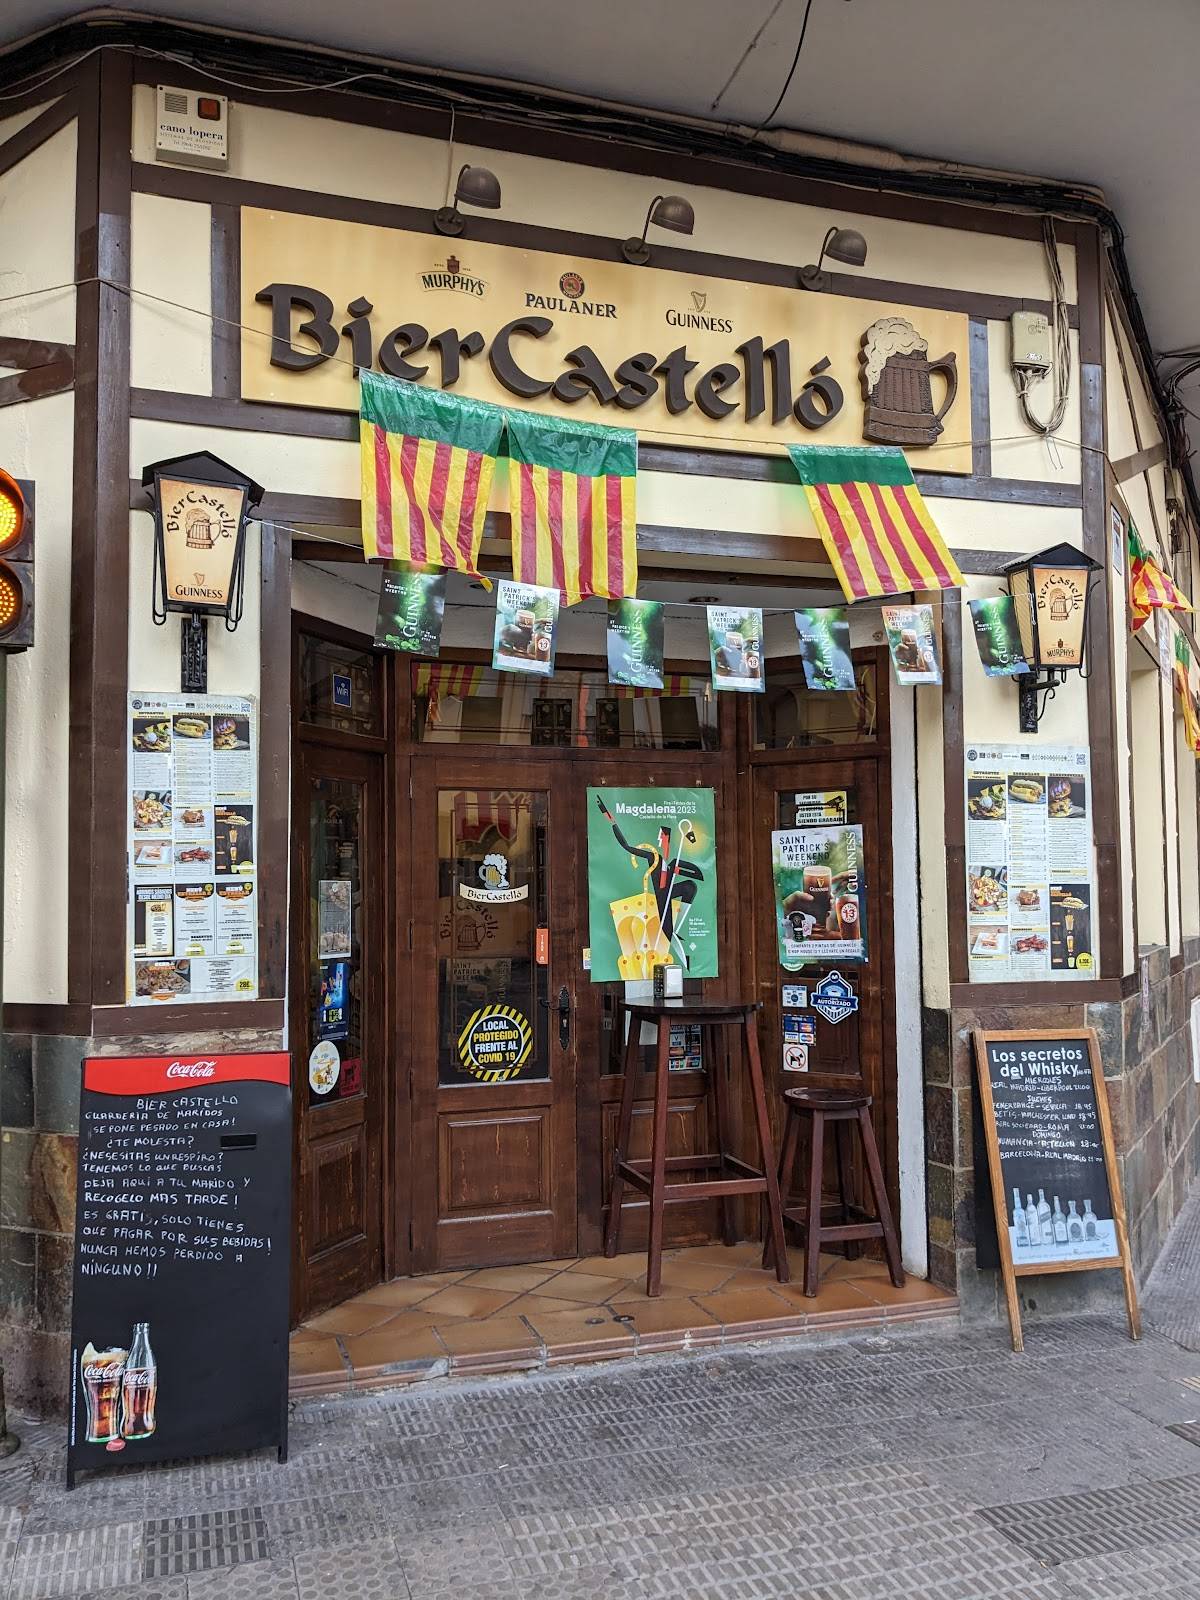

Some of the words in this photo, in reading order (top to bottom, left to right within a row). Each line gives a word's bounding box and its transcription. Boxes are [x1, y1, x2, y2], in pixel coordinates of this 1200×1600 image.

[160, 124, 186, 134] cano
[189, 126, 223, 140] lopera
[525, 292, 617, 319] PAULANER
[666, 309, 734, 333] GUINNESS
[255, 282, 844, 430] BierCastelló
[175, 585, 223, 598] GUINNESS
[752, 613, 760, 651] GUINNESS
[992, 607, 1009, 664] GUINNESS
[631, 608, 643, 673] GUINNESS
[615, 803, 676, 816] Magdalena
[677, 805, 697, 814] 2023
[779, 835, 806, 845] SAINT
[782, 842, 830, 853] PATRICK'S
[786, 852, 830, 861] WEEKEND
[846, 832, 859, 892] GUINNESS
[467, 889, 522, 901] BierCastelló
[844, 909, 855, 918] 13
[816, 998, 852, 1007] AUTORIZADO
[482, 1020, 509, 1031] LOCAL
[473, 1030, 519, 1042] PROTEGIDO
[474, 1042, 506, 1053] FRENTE
[507, 1041, 519, 1051] AL
[478, 1053, 503, 1063] COVID
[505, 1051, 516, 1061] 19
[992, 1049, 1016, 1062] Los
[1021, 1047, 1083, 1062] secretos
[166, 1060, 217, 1078] Coca-Cola
[1000, 1063, 1024, 1077] del
[1028, 1061, 1079, 1077] Whisky
[157, 1111, 171, 1120] DE
[93, 1125, 106, 1134] SE
[108, 1123, 136, 1133] PONE
[140, 1122, 179, 1132] PESADO
[184, 1121, 198, 1130] EN
[82, 1162, 134, 1174] TENEMOS
[138, 1163, 151, 1172] LO
[182, 1163, 222, 1173] BUSCAS
[84, 1177, 114, 1189] DEJA
[157, 1178, 165, 1187] A
[169, 1178, 187, 1188] TU
[243, 1176, 251, 1187] Y
[84, 1192, 144, 1204] RECOGELO
[150, 1193, 178, 1205] MAS
[84, 1210, 98, 1220] ES
[162, 1215, 192, 1225] SOLO
[83, 1226, 107, 1237] QUE
[113, 1227, 154, 1240] PAGAR
[161, 1230, 188, 1244] POR
[193, 1236, 219, 1248] SUS
[80, 1243, 118, 1257] NUNCA
[125, 1247, 167, 1257] HEMOS
[235, 1254, 244, 1262] A
